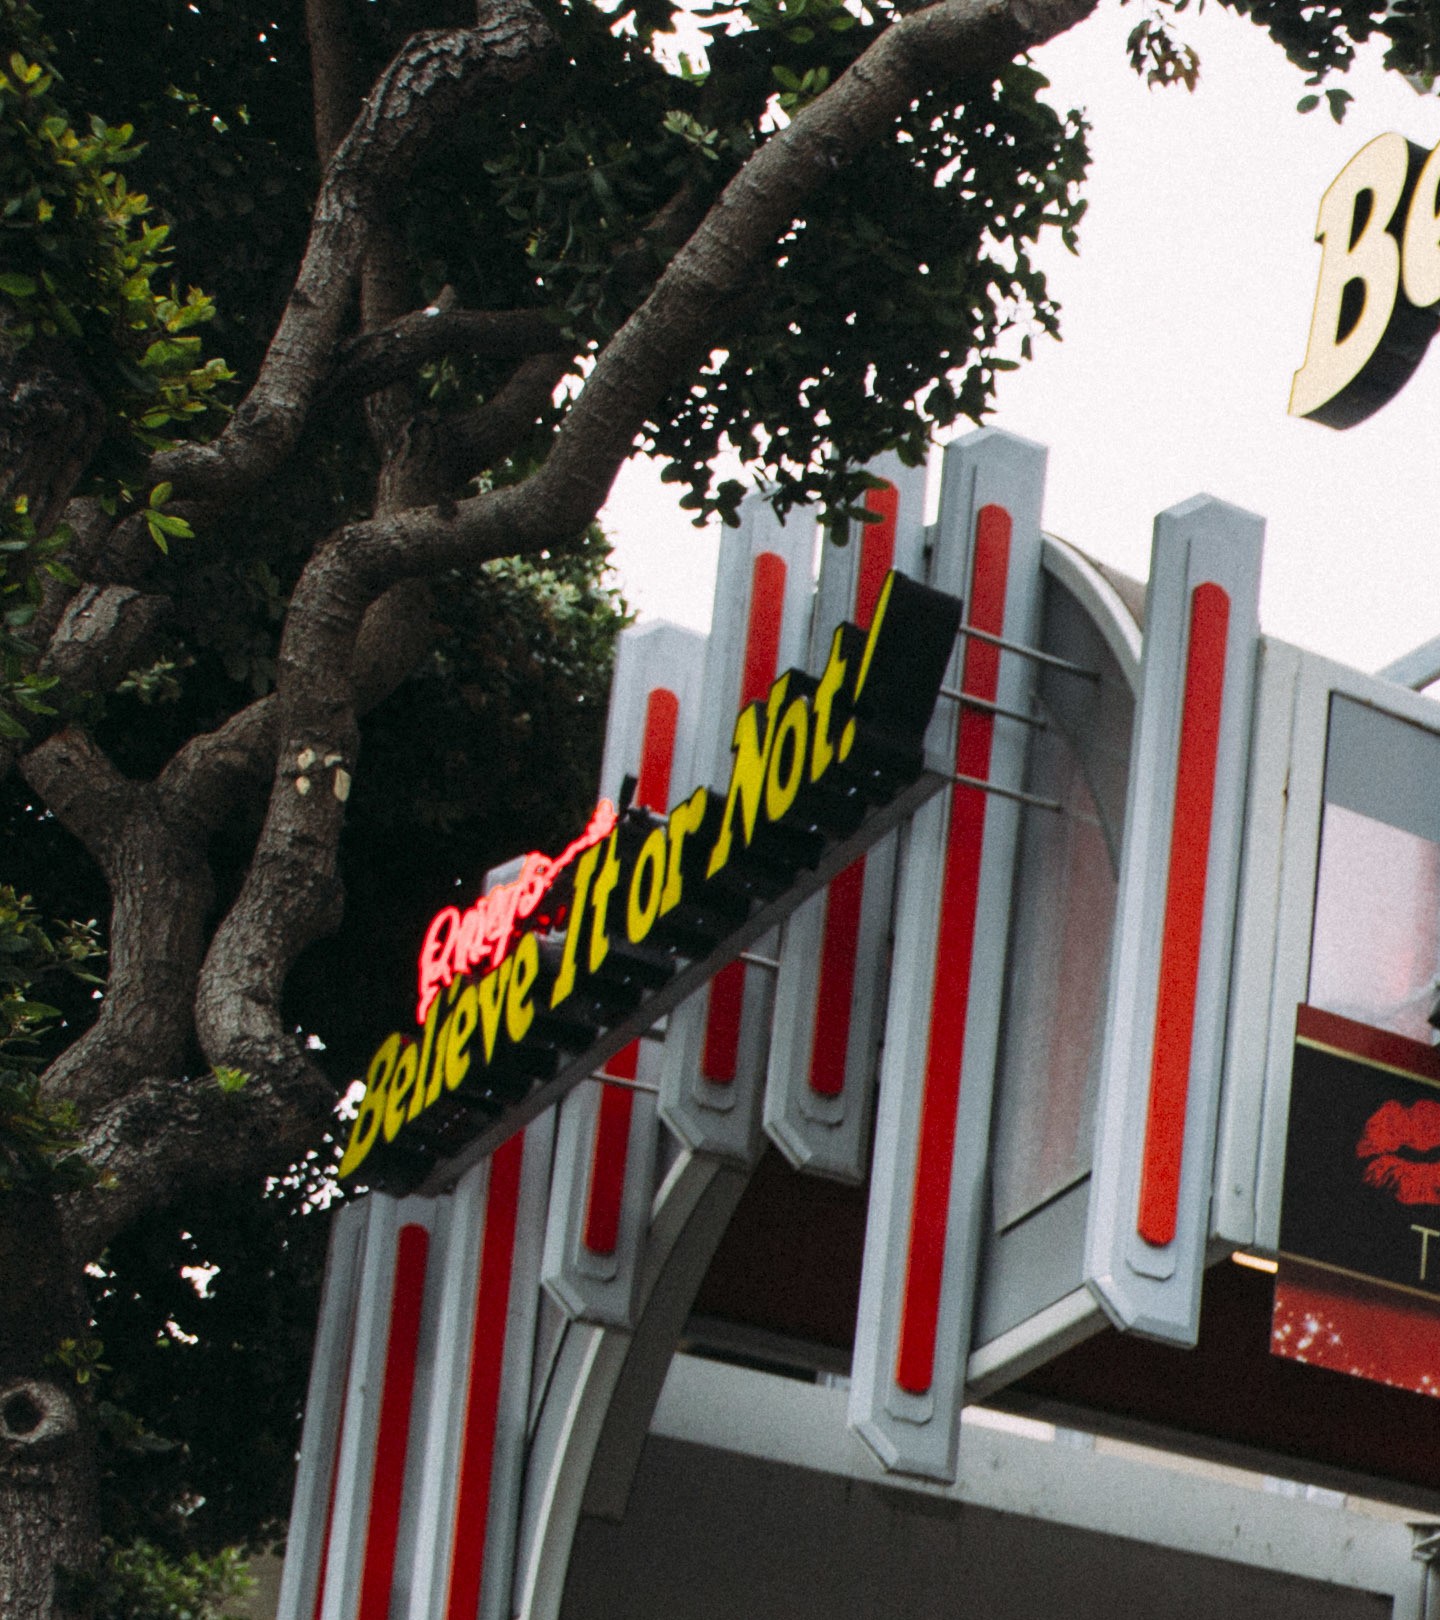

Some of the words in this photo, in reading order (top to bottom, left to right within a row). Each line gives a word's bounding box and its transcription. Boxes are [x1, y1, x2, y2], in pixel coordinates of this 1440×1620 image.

[338, 930, 540, 1179] Believe
[550, 824, 620, 1009] It
[625, 786, 707, 944] or
[706, 568, 897, 881] Not!
